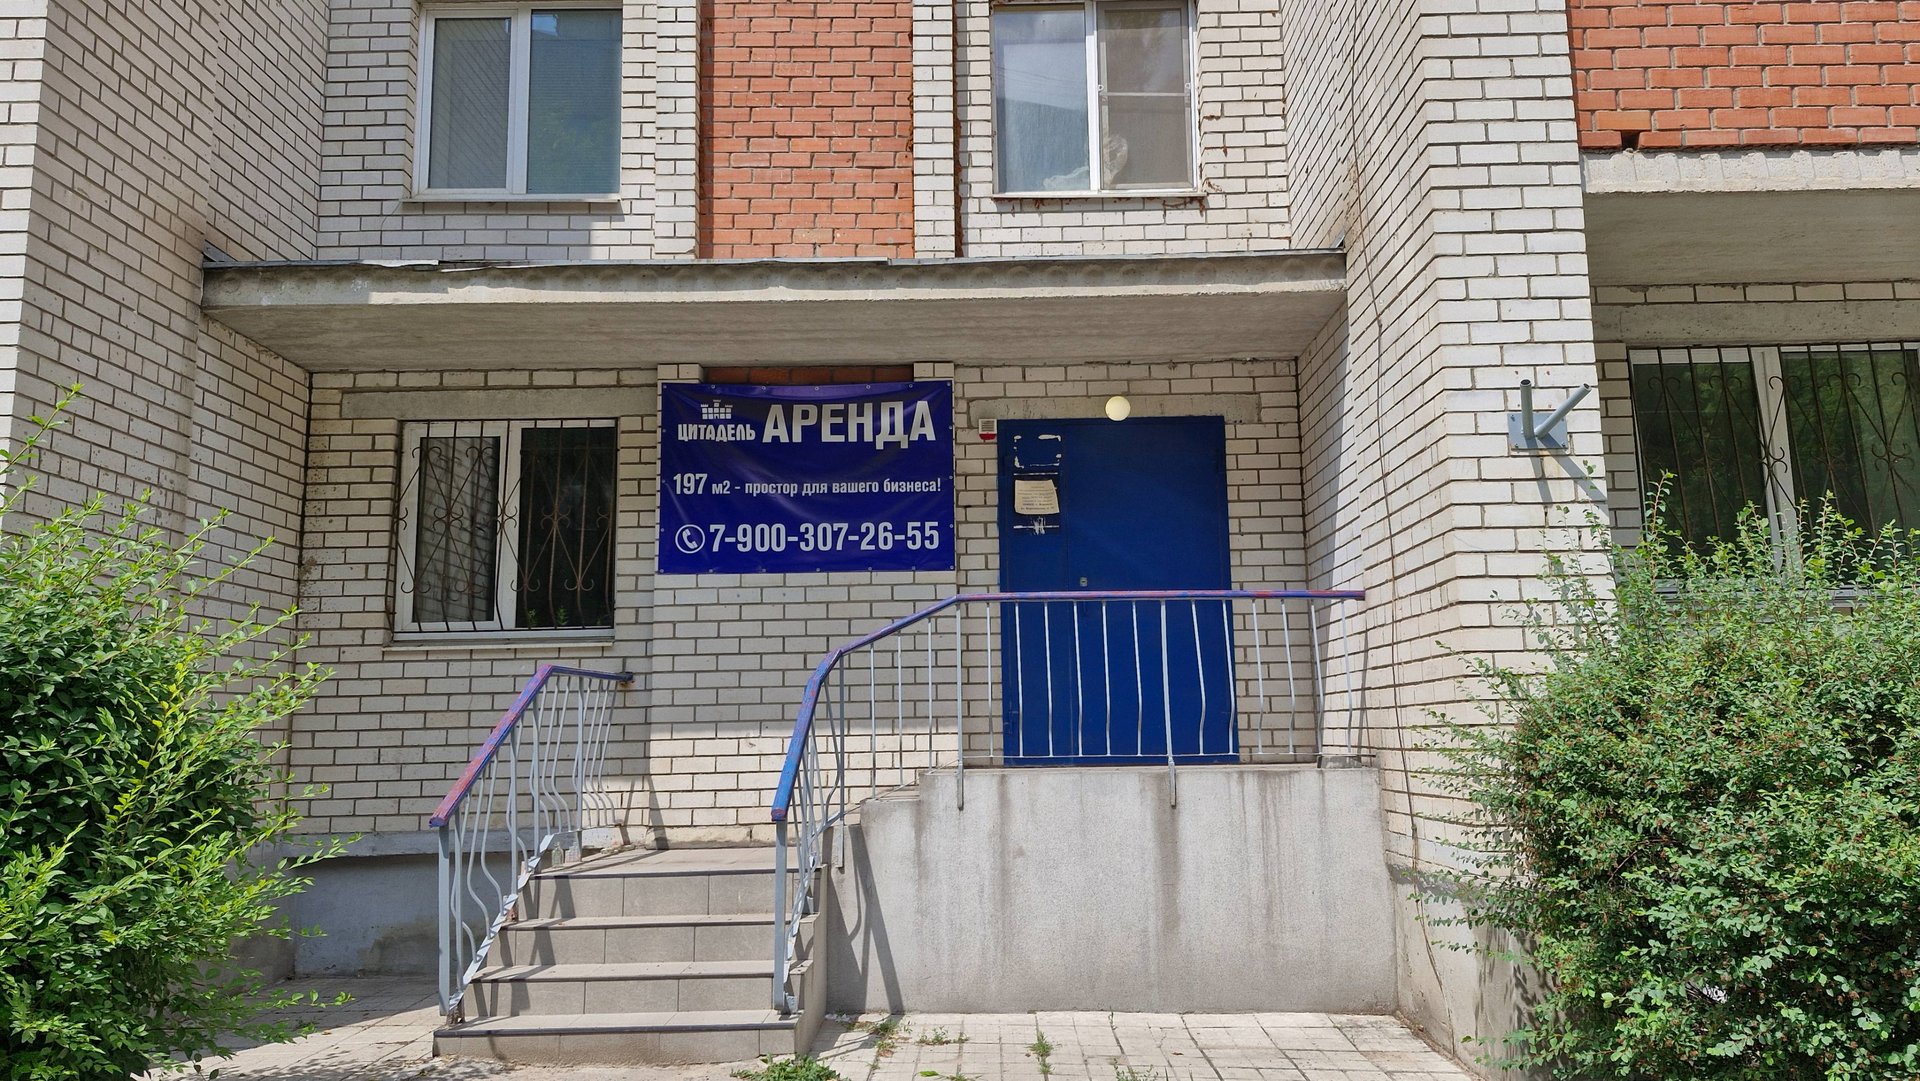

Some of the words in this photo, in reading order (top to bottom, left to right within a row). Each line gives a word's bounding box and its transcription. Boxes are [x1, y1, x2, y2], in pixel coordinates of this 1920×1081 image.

[677, 423, 756, 442] ЦИТАДЕЛЬ
[762, 400, 936, 450] АРЕНДА
[673, 473, 708, 495] 197
[711, 480, 731, 494] м2
[745, 482, 798, 497] простор
[802, 482, 828, 496] для
[832, 480, 879, 493] вашего
[883, 477, 941, 493] бизнеса!
[709, 521, 940, 552] 7-900-307-26-55
